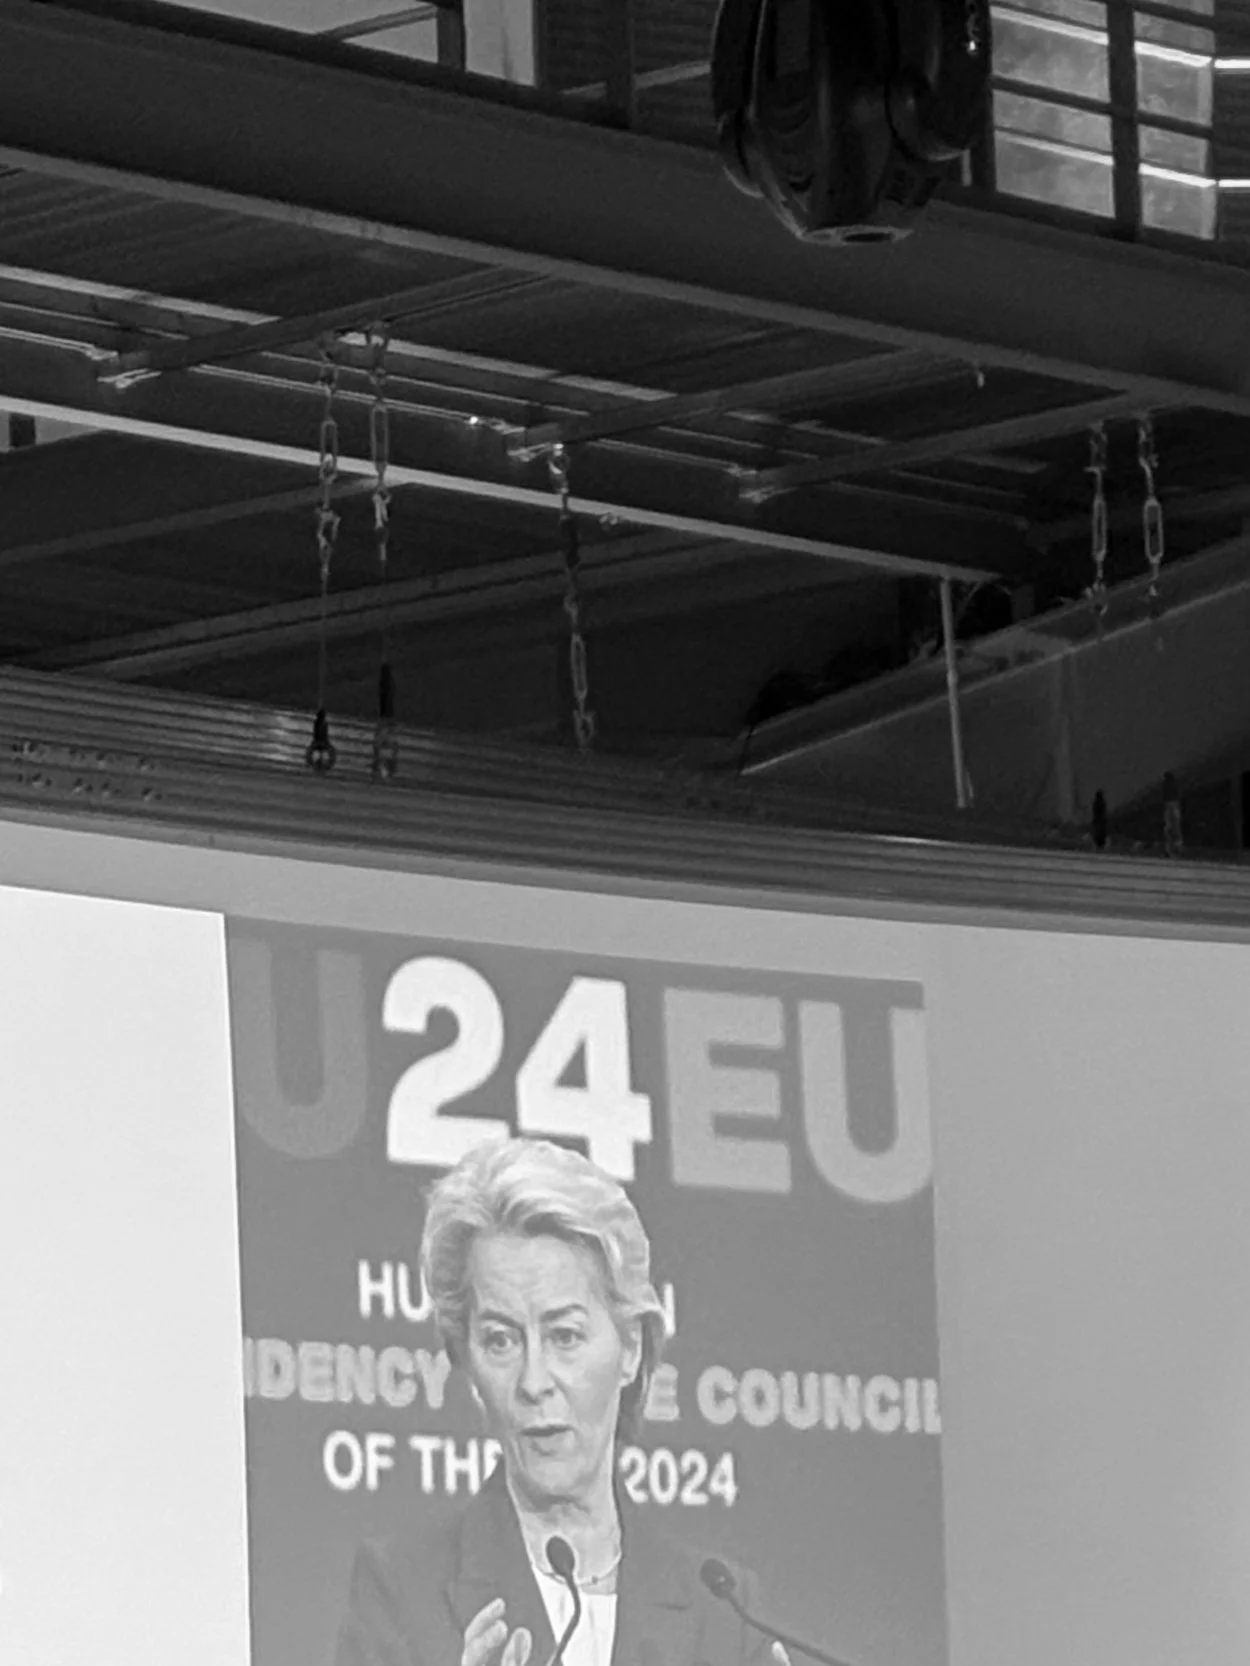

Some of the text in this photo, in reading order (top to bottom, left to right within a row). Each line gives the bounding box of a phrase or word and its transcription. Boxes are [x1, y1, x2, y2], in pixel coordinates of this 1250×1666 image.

[697, 1365, 942, 1434] COUNCIL
[323, 1429, 396, 1491] OF
[619, 1446, 739, 1507] 2024
